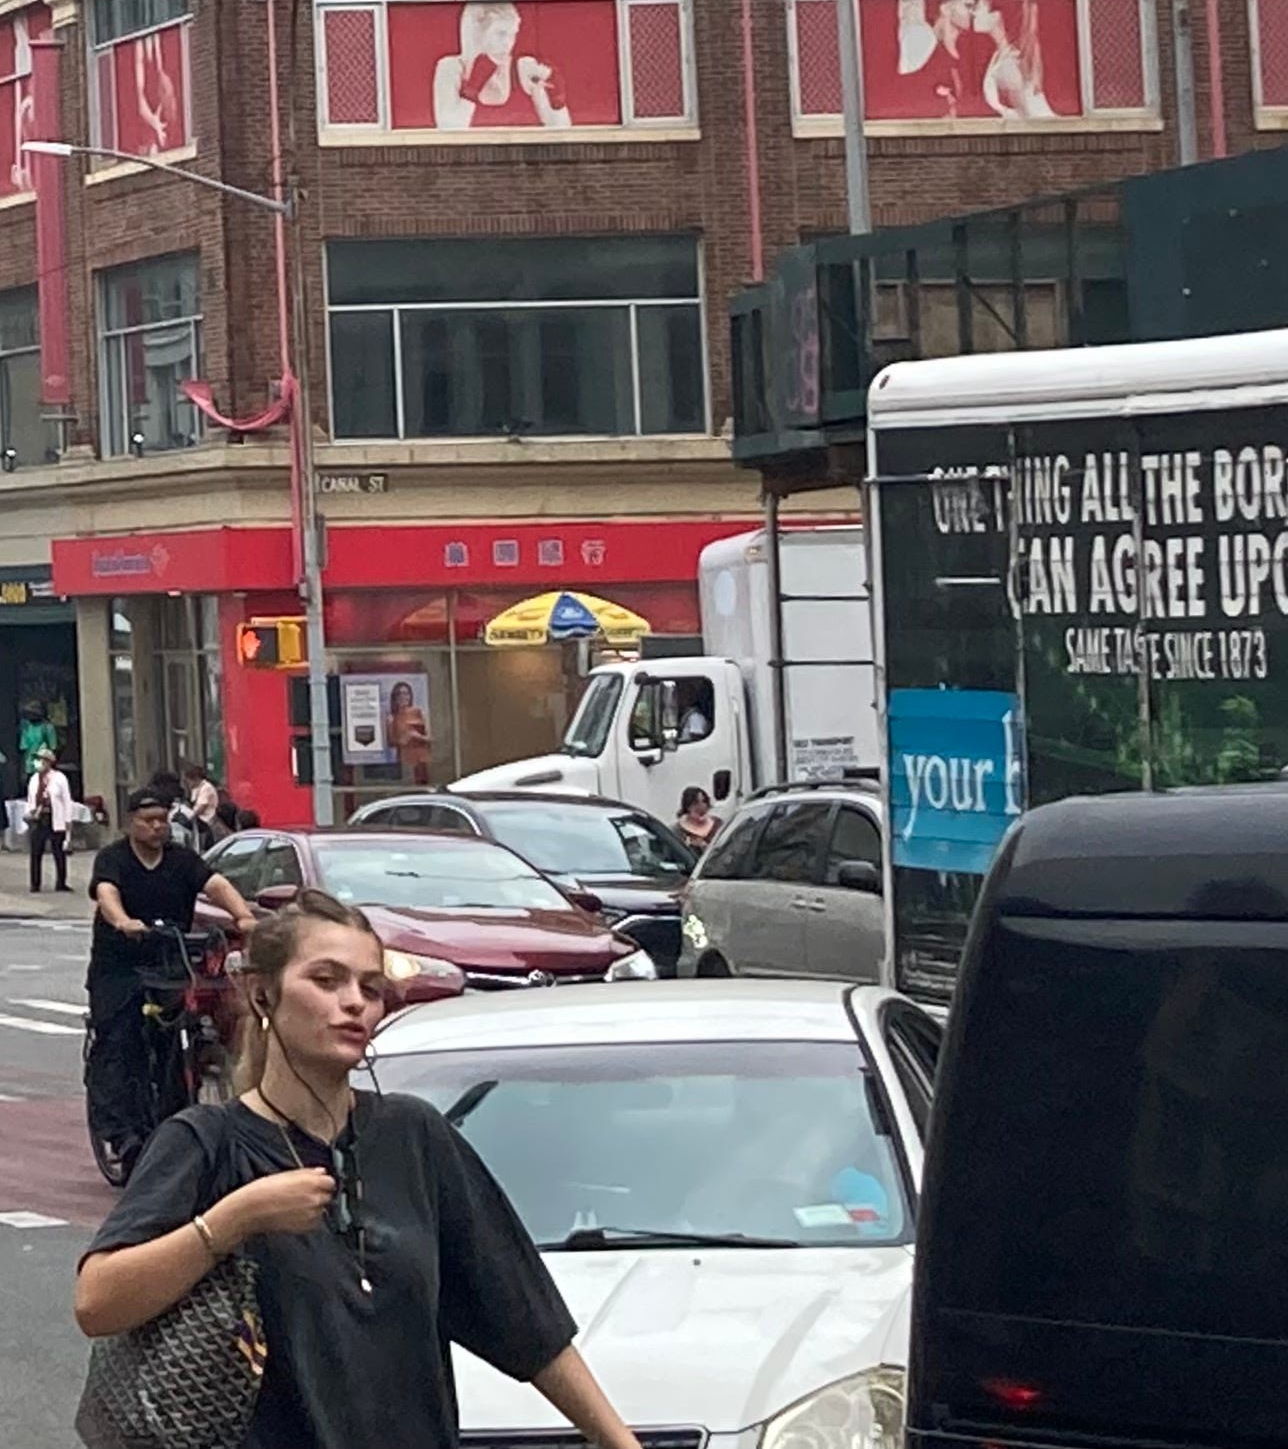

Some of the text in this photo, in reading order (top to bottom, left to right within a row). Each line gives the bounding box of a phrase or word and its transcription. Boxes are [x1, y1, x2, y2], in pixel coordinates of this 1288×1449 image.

[1079, 452, 1132, 523] ALL
[1142, 452, 1203, 526] THE
[1214, 445, 1288, 523] BOR
[1089, 534, 1206, 618] AGREE
[1066, 627, 1111, 674] SAME
[1163, 631, 1215, 679] SINCE
[1218, 629, 1267, 679] 1873
[903, 753, 994, 843] your
